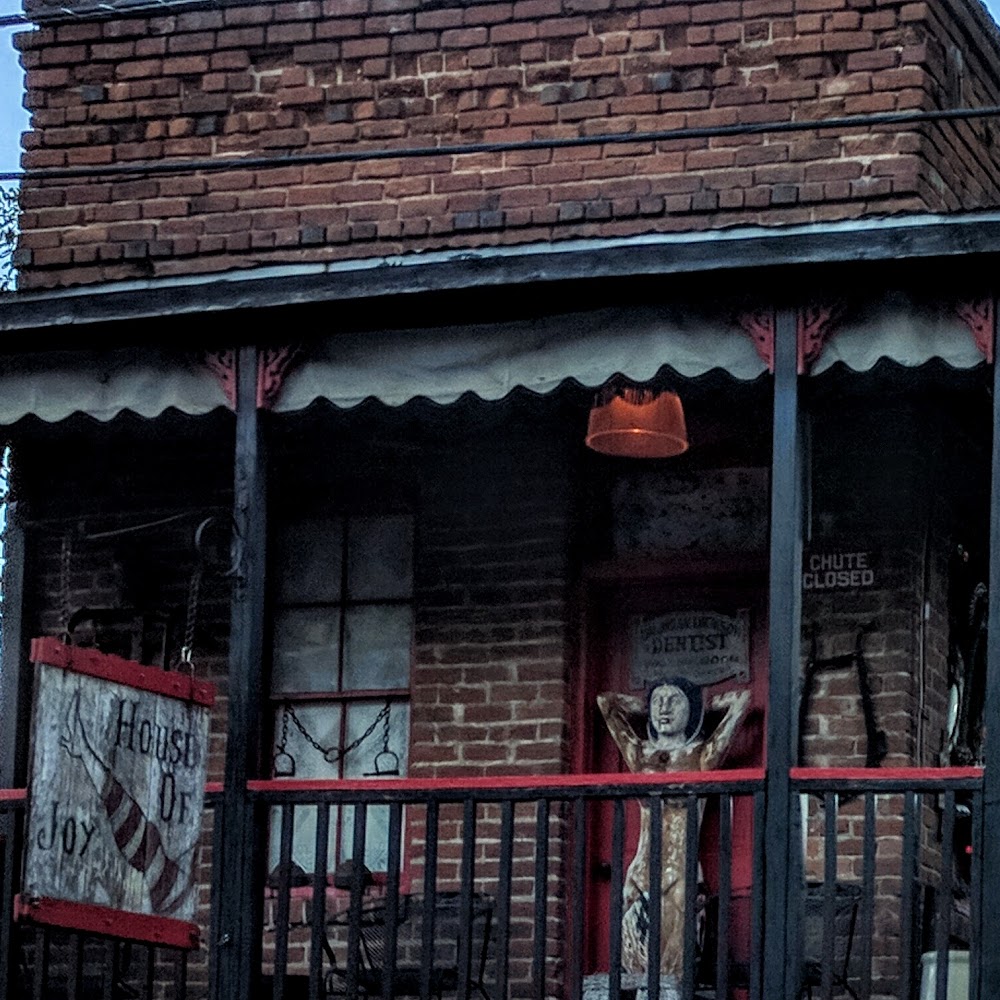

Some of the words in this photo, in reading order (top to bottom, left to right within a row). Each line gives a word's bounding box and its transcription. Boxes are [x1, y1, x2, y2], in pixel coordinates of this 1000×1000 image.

[809, 552, 869, 571] CHUTE
[802, 569, 875, 589] CLOSED
[651, 634, 727, 654] DENTIST
